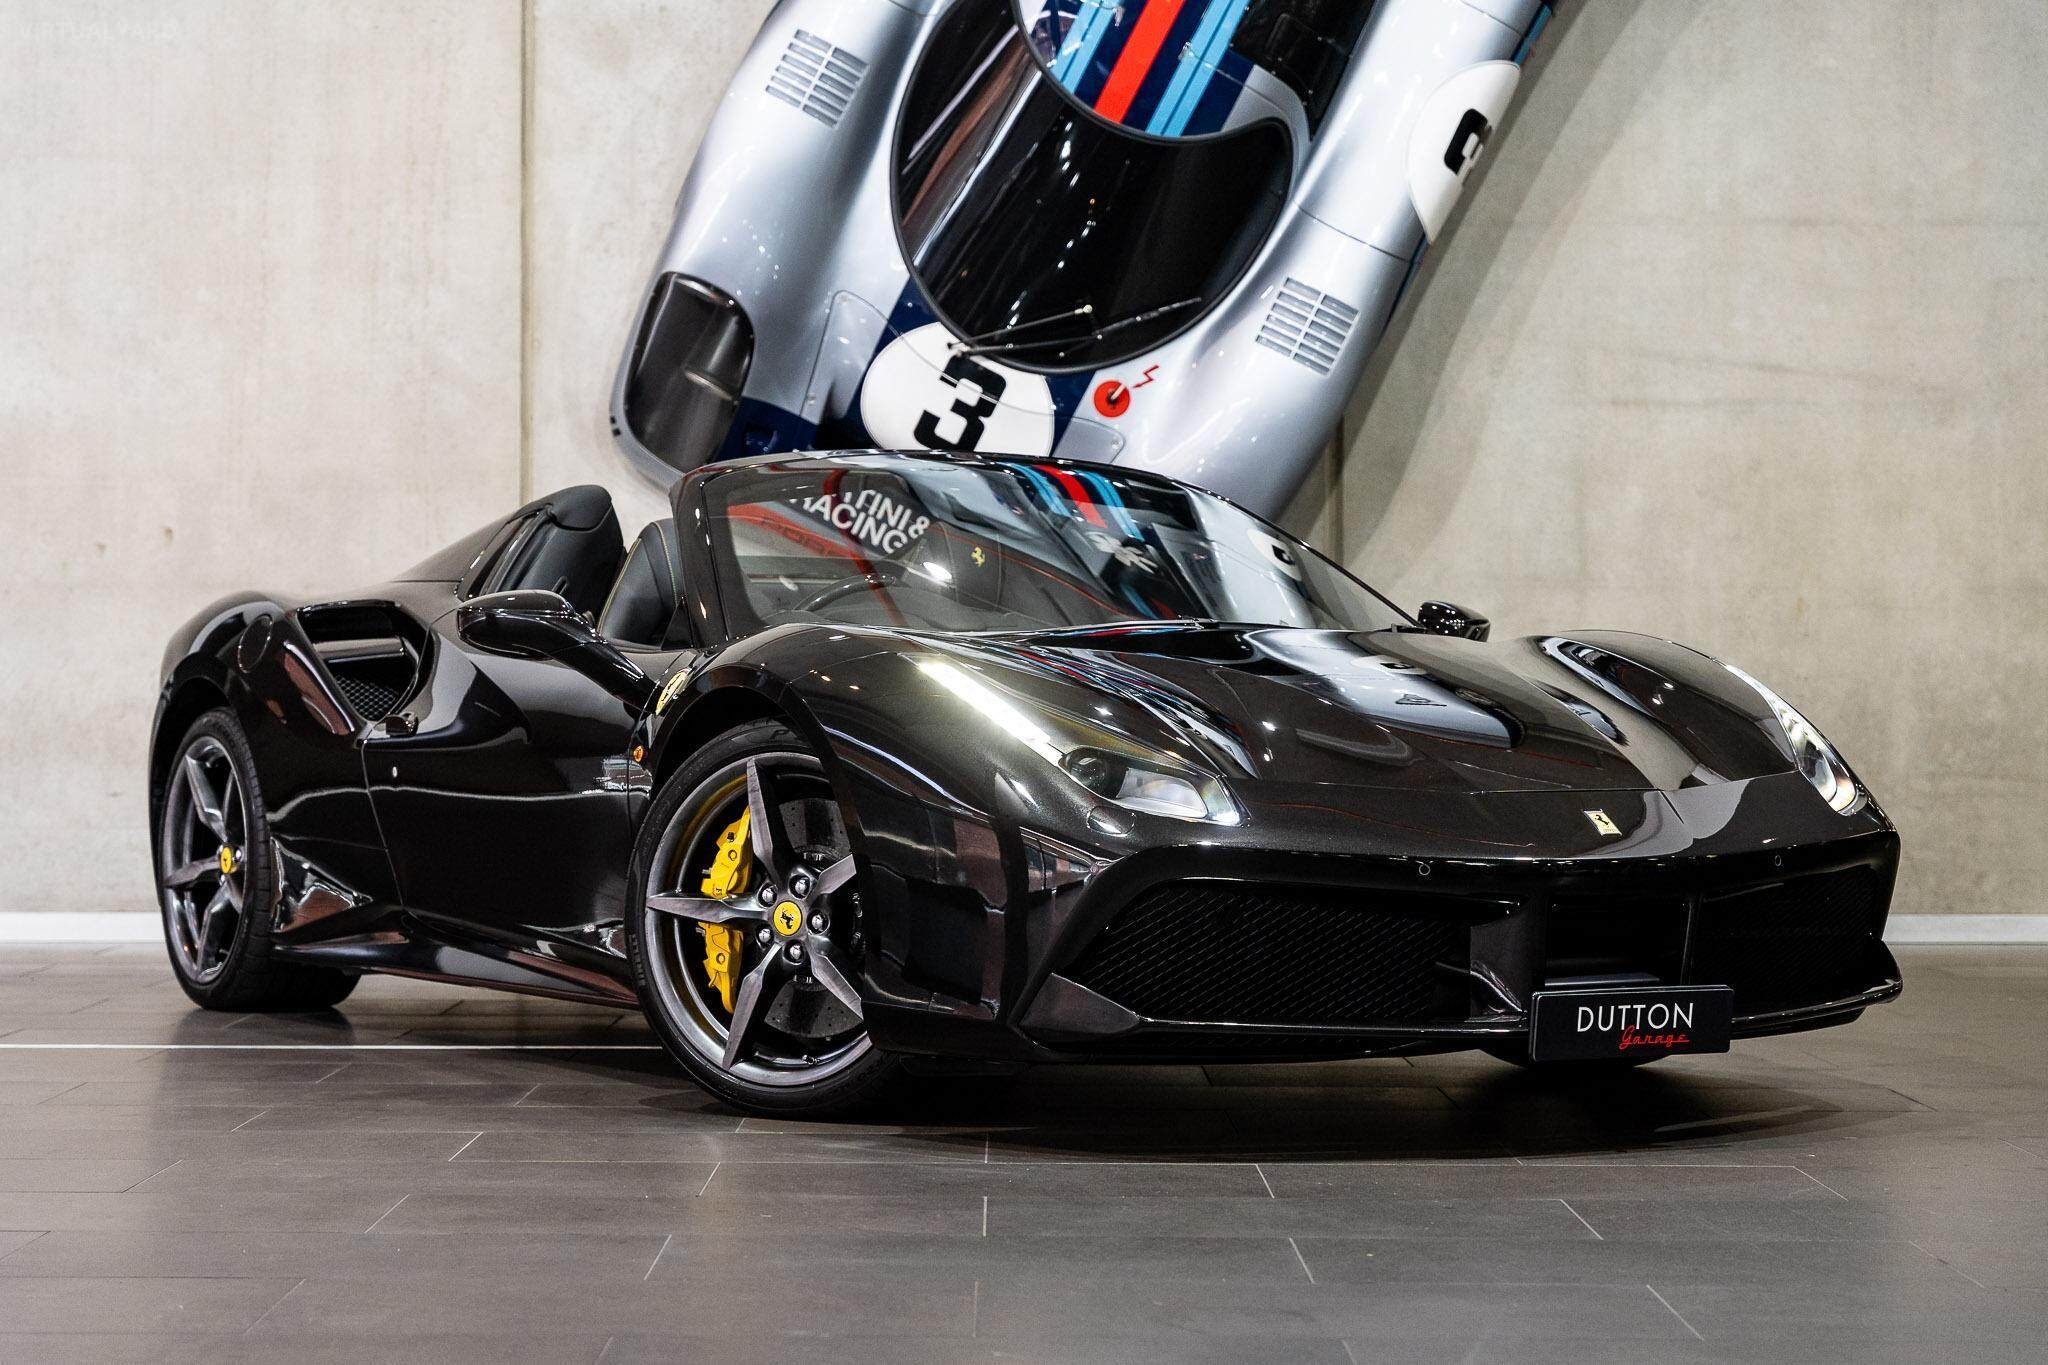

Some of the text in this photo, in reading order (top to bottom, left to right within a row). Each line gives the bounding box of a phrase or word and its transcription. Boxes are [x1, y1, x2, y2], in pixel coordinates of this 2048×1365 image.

[913, 354, 1007, 452] 3
[1577, 1002, 1694, 1033] DUTTON
[1618, 1024, 1690, 1050] Garage
